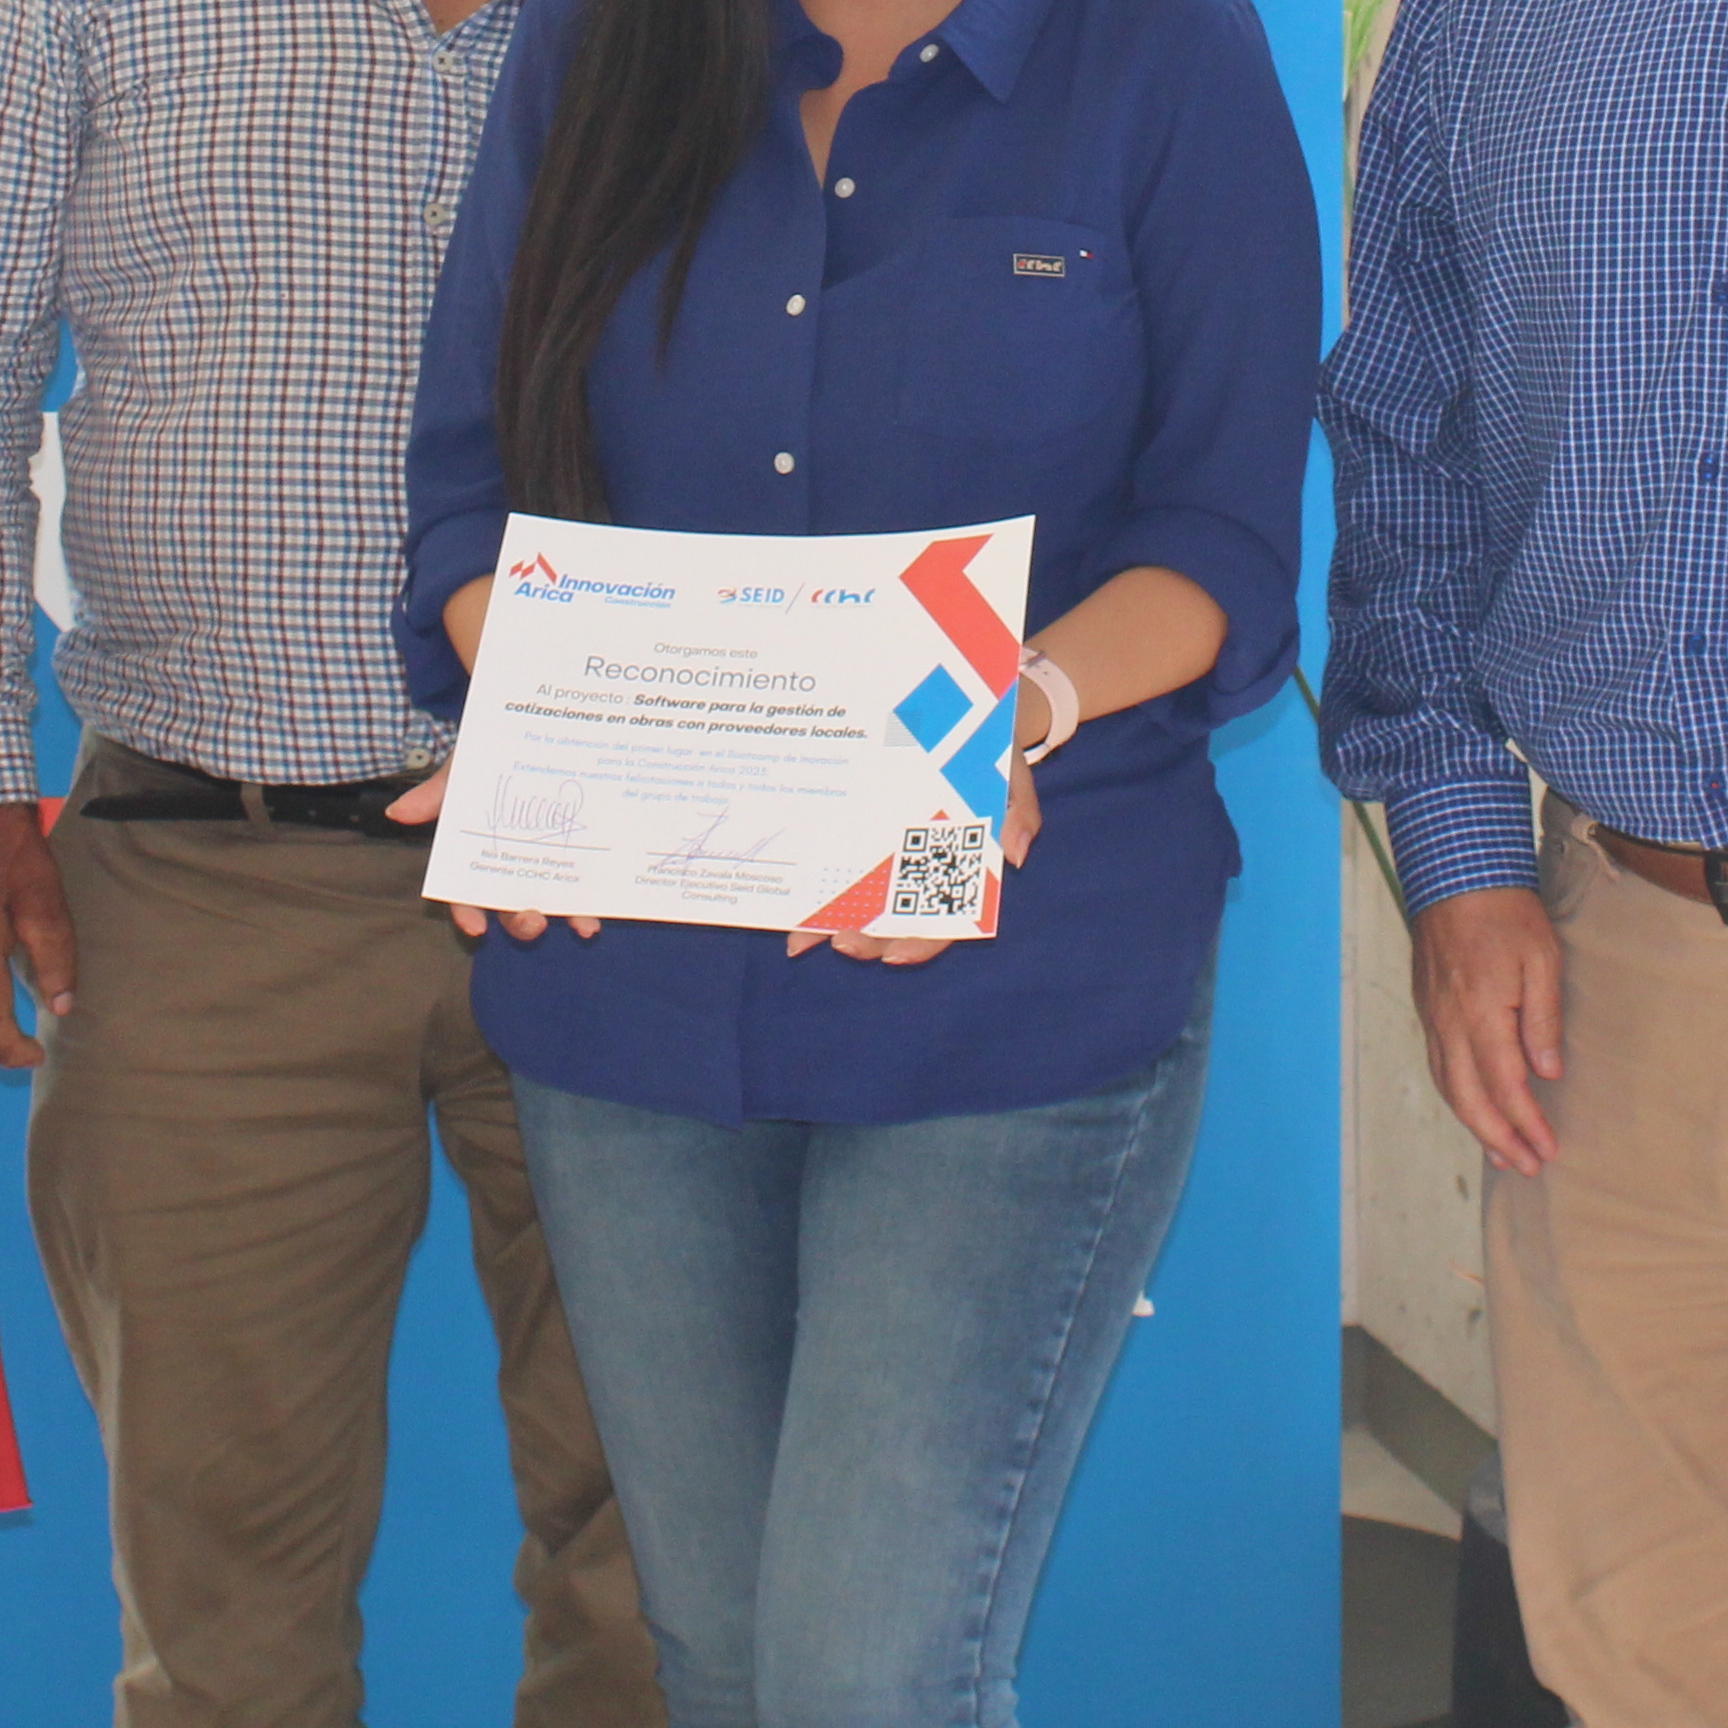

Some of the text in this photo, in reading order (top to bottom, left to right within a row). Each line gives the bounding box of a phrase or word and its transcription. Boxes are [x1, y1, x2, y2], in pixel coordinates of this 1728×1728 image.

[514, 581, 574, 604] Arica
[559, 574, 675, 600] Innovación
[740, 587, 785, 604] SEID
[654, 642, 758, 659] Otorgamos este
[584, 655, 816, 692] Reconocimiento
[536, 684, 552, 696] Al
[554, 686, 623, 704] proyecto
[633, 693, 706, 710] Software
[708, 700, 746, 713] para
[749, 702, 764, 714] la
[766, 703, 824, 718] gestión
[827, 705, 847, 718] de
[505, 701, 868, 739] cotizaciones en obras con proveedores locales.
